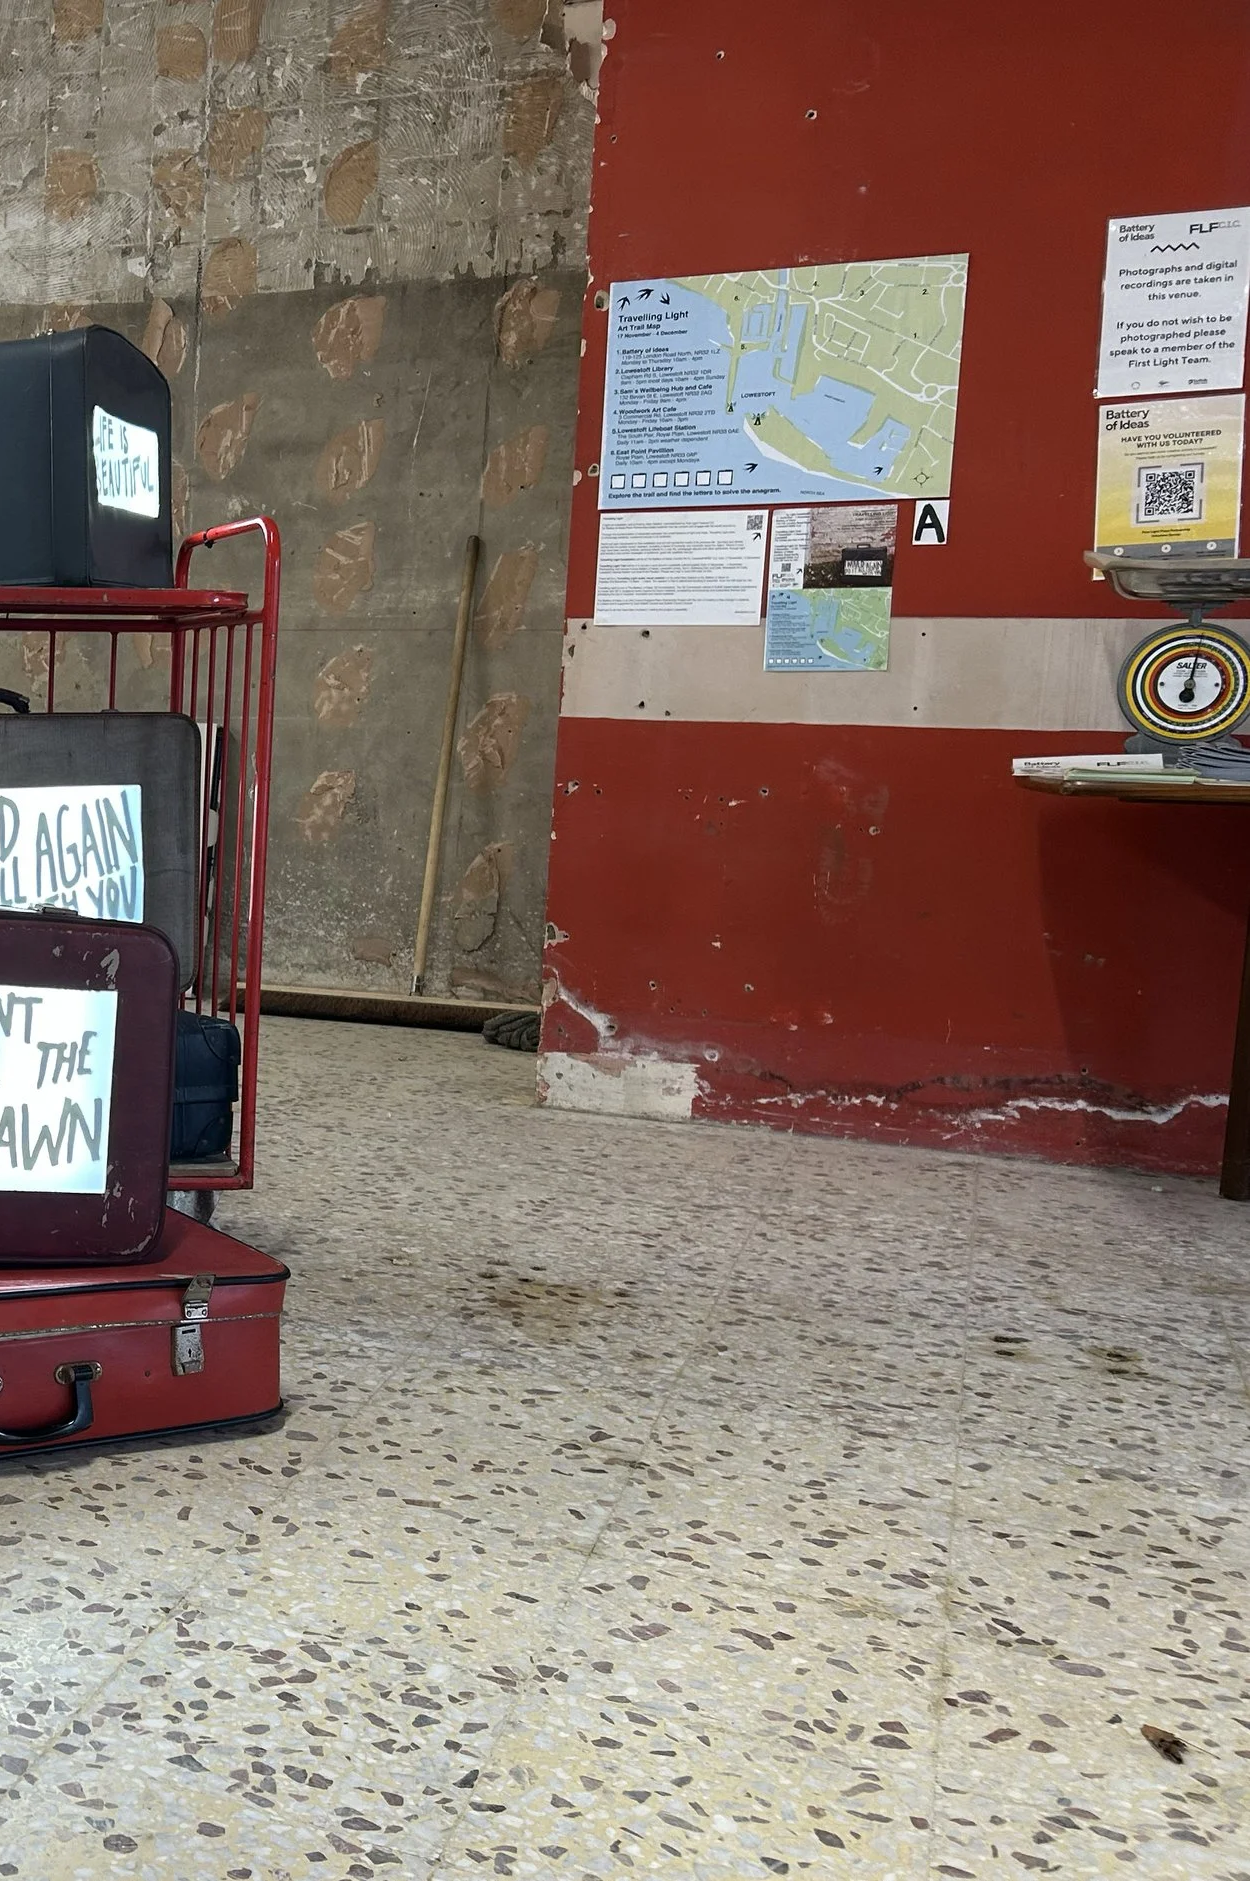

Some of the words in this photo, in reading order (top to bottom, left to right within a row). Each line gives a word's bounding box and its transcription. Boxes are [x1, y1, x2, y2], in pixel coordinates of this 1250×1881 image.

[1118, 222, 1154, 234] Battery
[1189, 221, 1219, 234] FLF
[1118, 234, 1129, 242] of
[1130, 232, 1154, 241] Ideas
[1118, 264, 1182, 278] Photographs
[1184, 262, 1203, 271] and
[1205, 259, 1237, 271] digital
[1120, 278, 1172, 291] recordings
[1193, 274, 1221, 283] taken
[1224, 273, 1233, 281] in
[1147, 292, 1165, 301] this
[1168, 290, 1201, 299] venue.
[617, 312, 662, 325] Travelling
[665, 309, 688, 321] Light
[1116, 321, 1123, 329] If
[1125, 321, 1144, 330] you
[1146, 318, 1159, 327] do
[1161, 317, 1179, 326] not
[1180, 315, 1203, 325] wish
[1206, 315, 1216, 323] to
[1219, 313, 1232, 322] be
[629, 323, 644, 331] Trail
[645, 322, 660, 330] Map
[1120, 329, 1191, 344] photographed
[1193, 327, 1226, 338] please
[1109, 347, 1138, 357] speak
[1140, 346, 1151, 354] to
[1161, 342, 1203, 353] member
[1205, 341, 1215, 349] of
[1218, 340, 1235, 348] the
[1128, 359, 1150, 368] First
[1152, 356, 1178, 368] Light
[1181, 354, 1211, 364] Team.
[740, 391, 776, 399] LOWESTOFT
[1105, 407, 1149, 422] Battery
[1105, 420, 1117, 431] of
[1119, 418, 1149, 429] Ideas
[95, 415, 114, 453] IFE
[119, 424, 129, 455] IS
[1121, 435, 1142, 443] HAVE
[1163, 429, 1221, 440] VOLUNTEERED
[1136, 441, 1157, 449] WITH
[1172, 437, 1202, 446] TODAY?
[914, 503, 946, 543] A
[1176, 662, 1208, 670] SALER
[35, 790, 139, 898] AGAIN
[86, 865, 137, 920] YOU
[35, 1030, 98, 1090] THE
